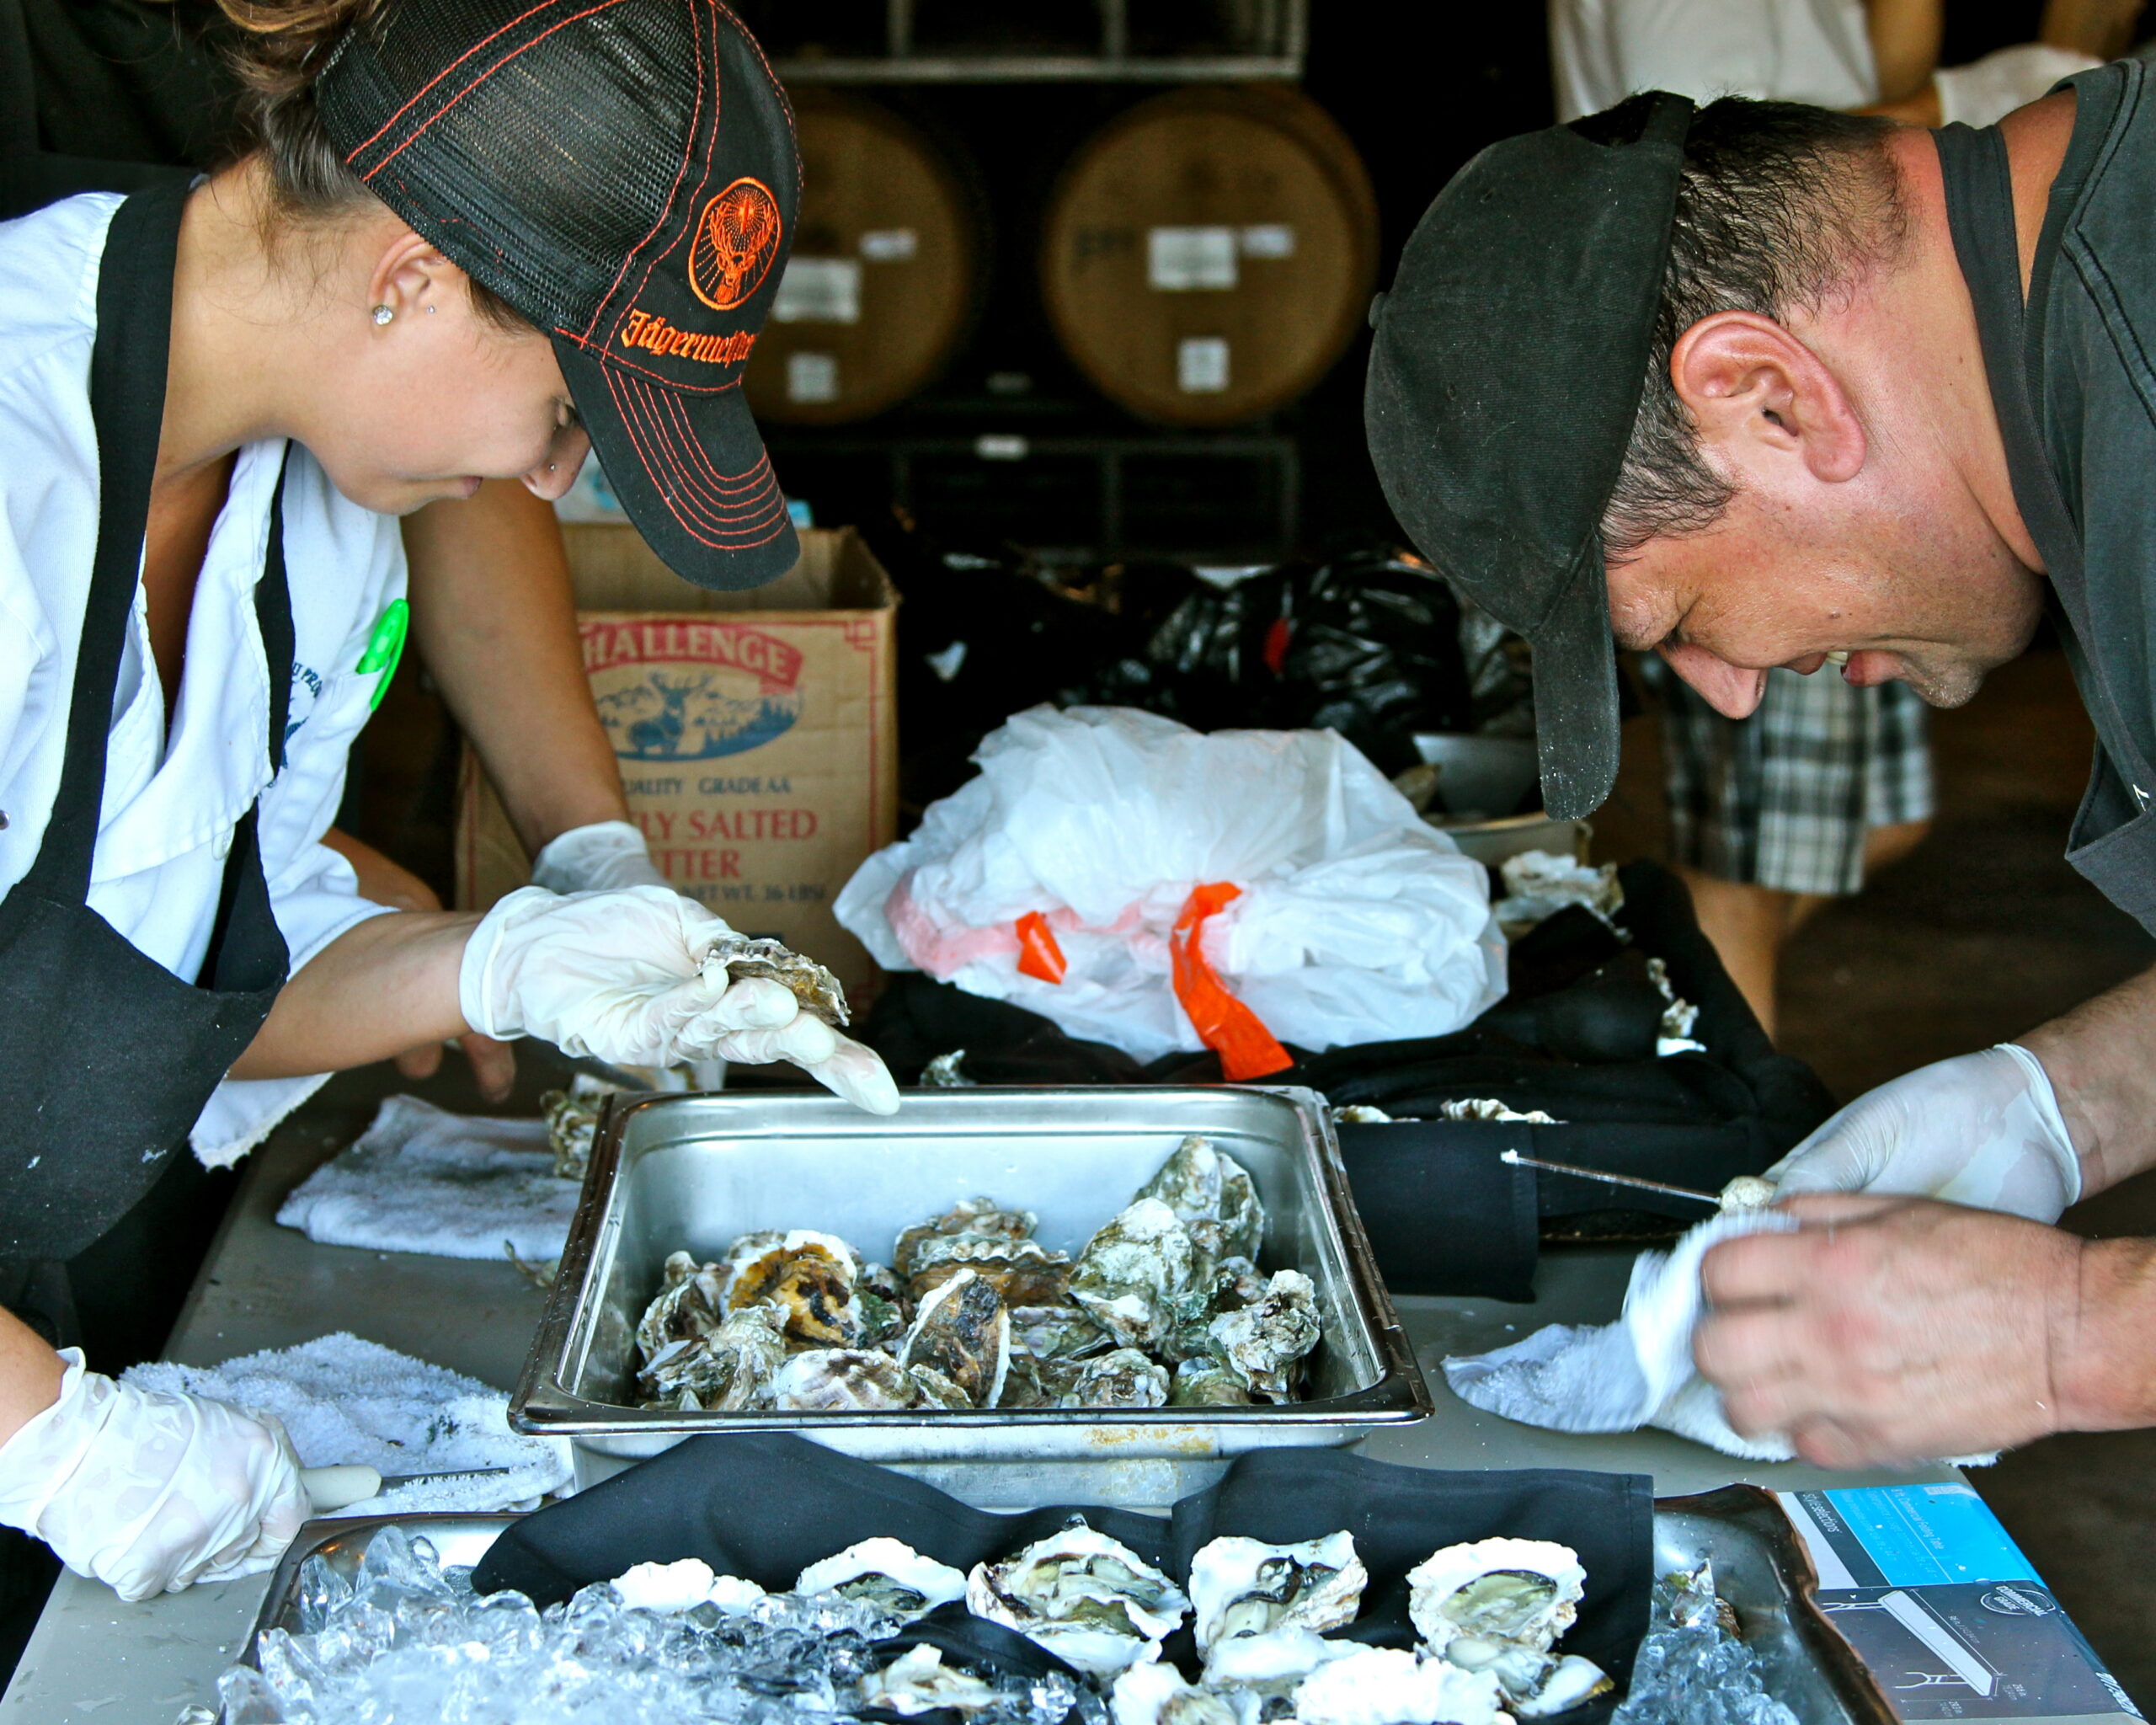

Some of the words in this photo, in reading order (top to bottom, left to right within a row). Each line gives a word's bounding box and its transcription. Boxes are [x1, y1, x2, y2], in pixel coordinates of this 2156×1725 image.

[583, 623, 790, 681] HALLENGE
[622, 777, 683, 795] UALITY
[698, 777, 761, 794] GRADE
[687, 808, 819, 841] SALTED
[651, 847, 743, 881] TTER
[1993, 1595, 2020, 1610] GRADE
[1995, 1585, 2049, 1617] COMMERCIAL
